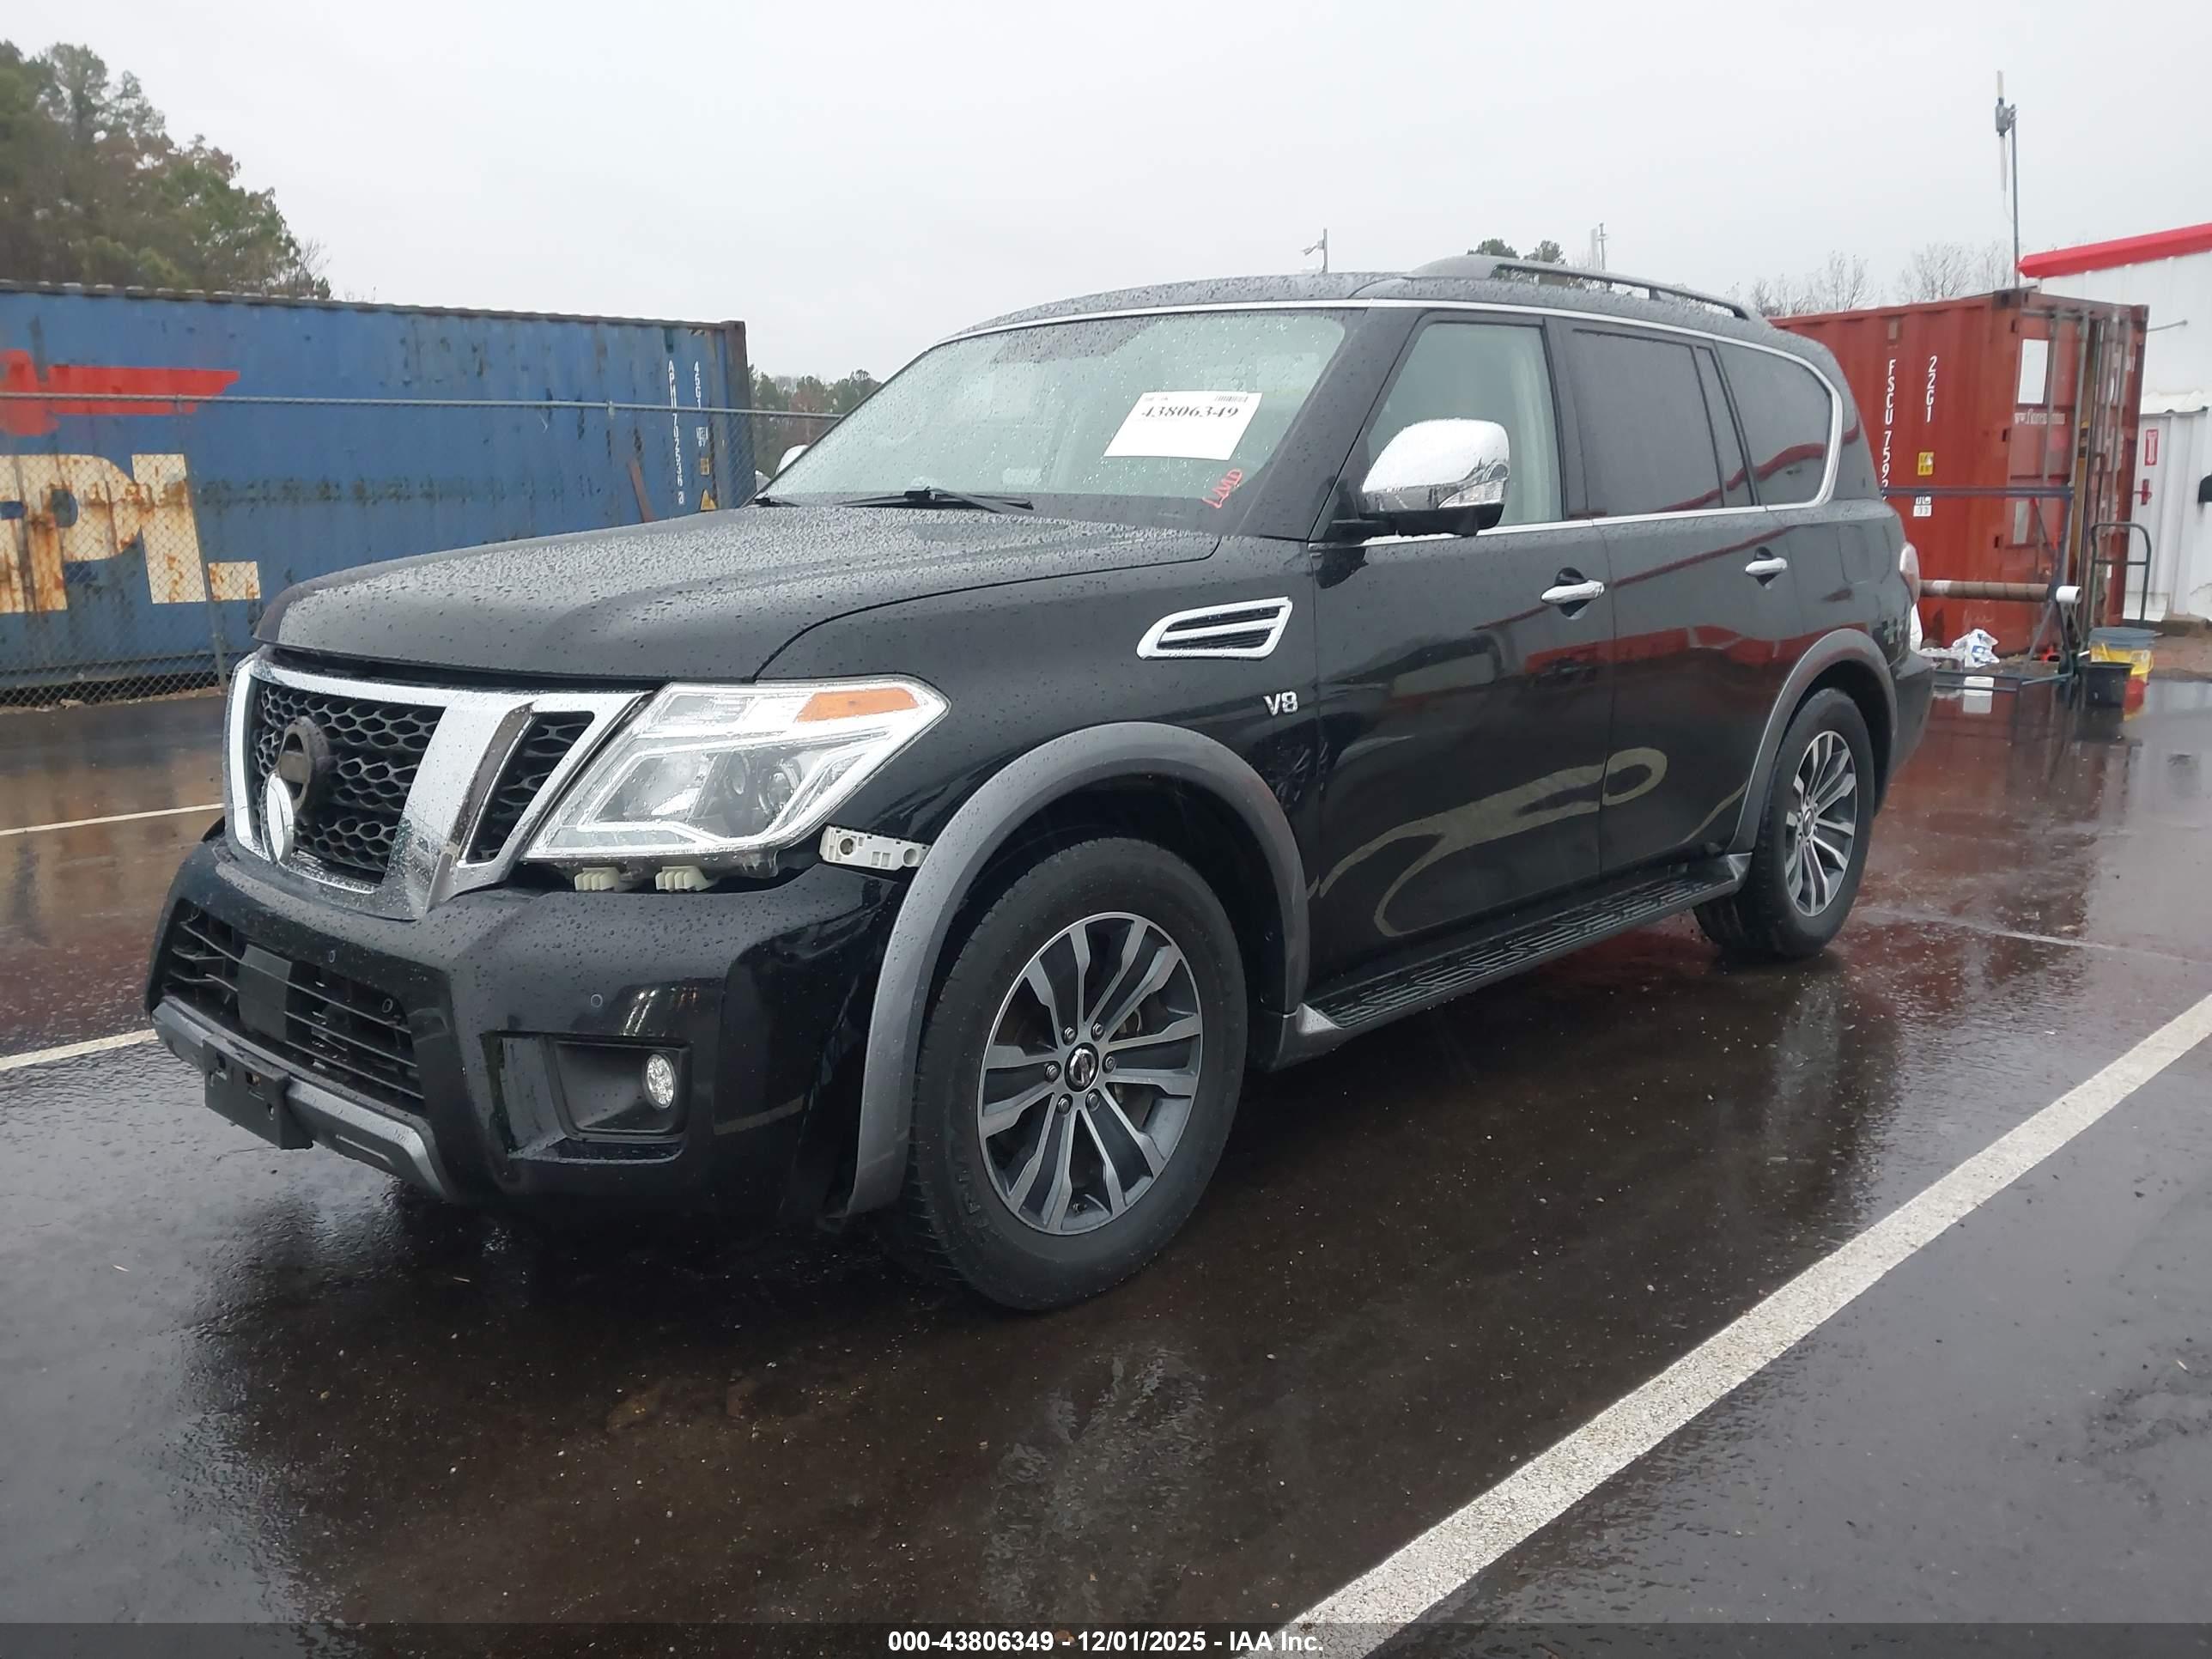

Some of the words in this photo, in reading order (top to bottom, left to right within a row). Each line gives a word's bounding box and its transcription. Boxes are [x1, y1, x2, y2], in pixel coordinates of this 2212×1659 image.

[1141, 405, 1239, 418] 43806349
[1885, 359, 1897, 425] FSCU
[1926, 356, 1937, 422] 22G1
[1262, 690, 1298, 716] V8
